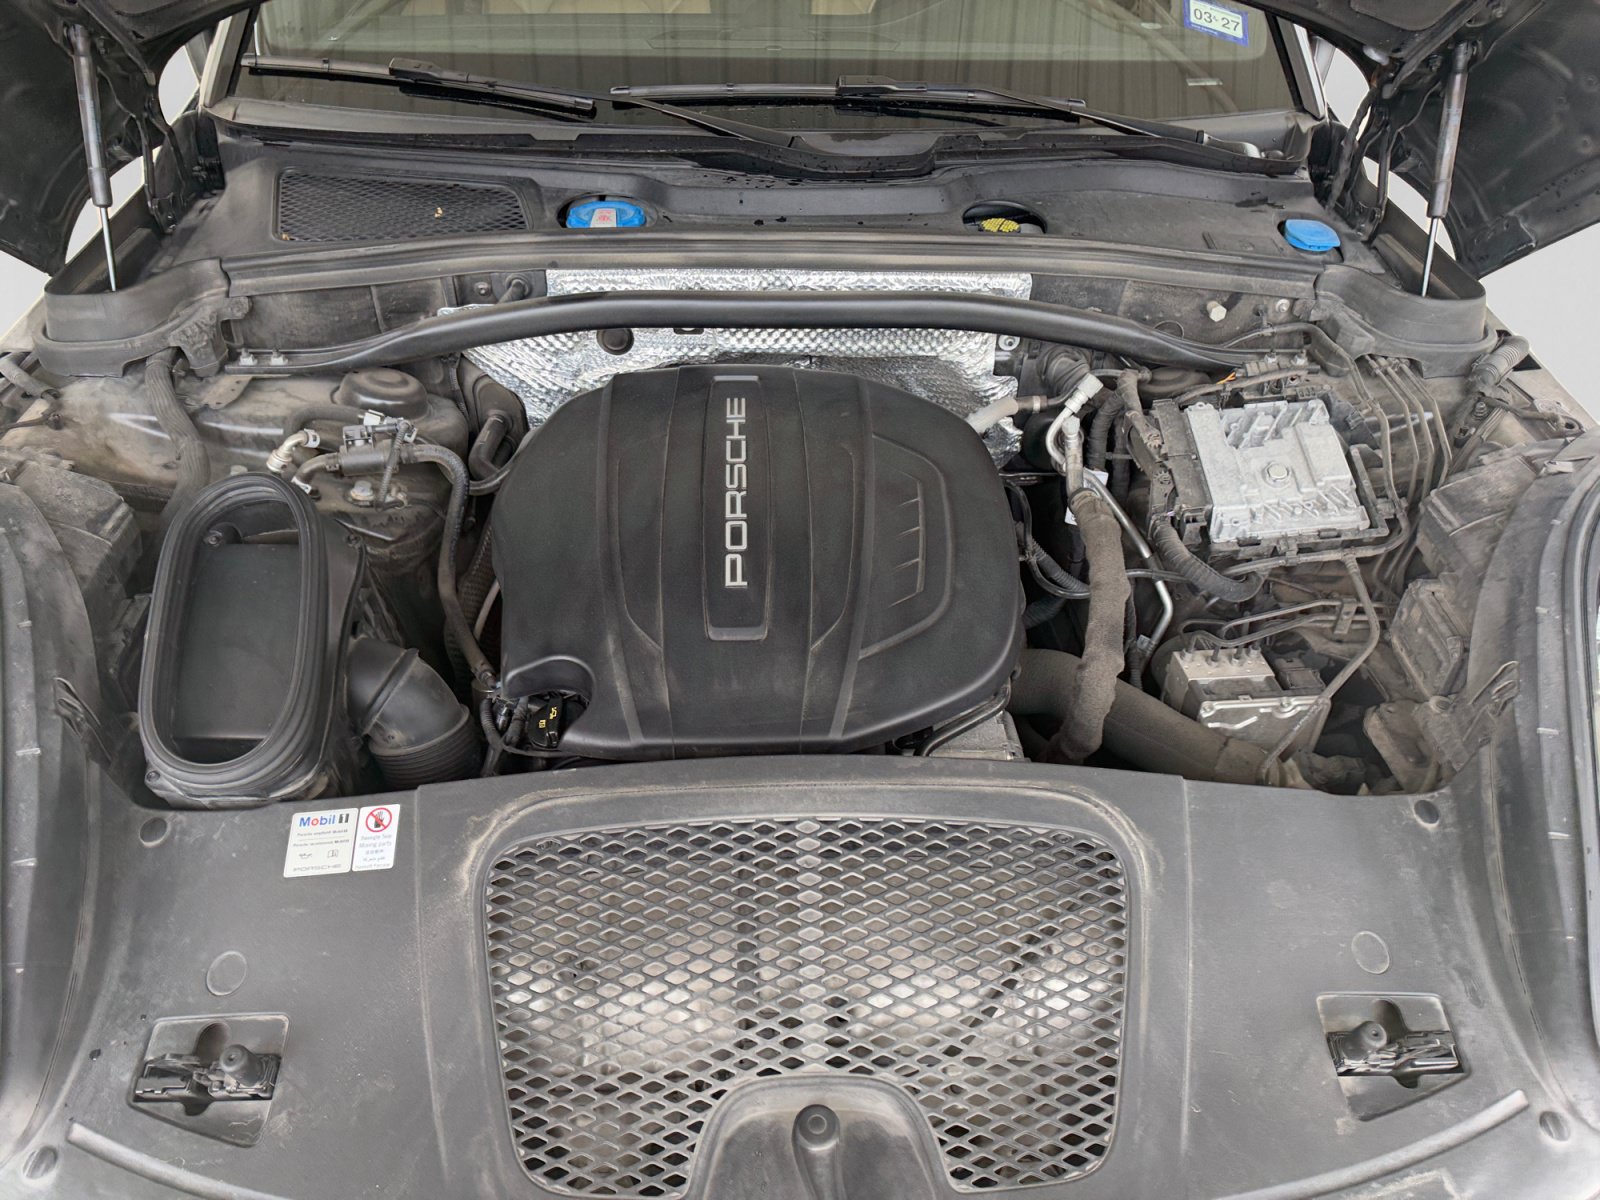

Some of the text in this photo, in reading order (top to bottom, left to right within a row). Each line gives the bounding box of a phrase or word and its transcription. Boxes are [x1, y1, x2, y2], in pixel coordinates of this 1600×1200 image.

[1193, 8, 1214, 24] 03
[1221, 17, 1241, 31] 27
[724, 397, 748, 588] PORSCHE
[299, 814, 336, 827] Mobil
